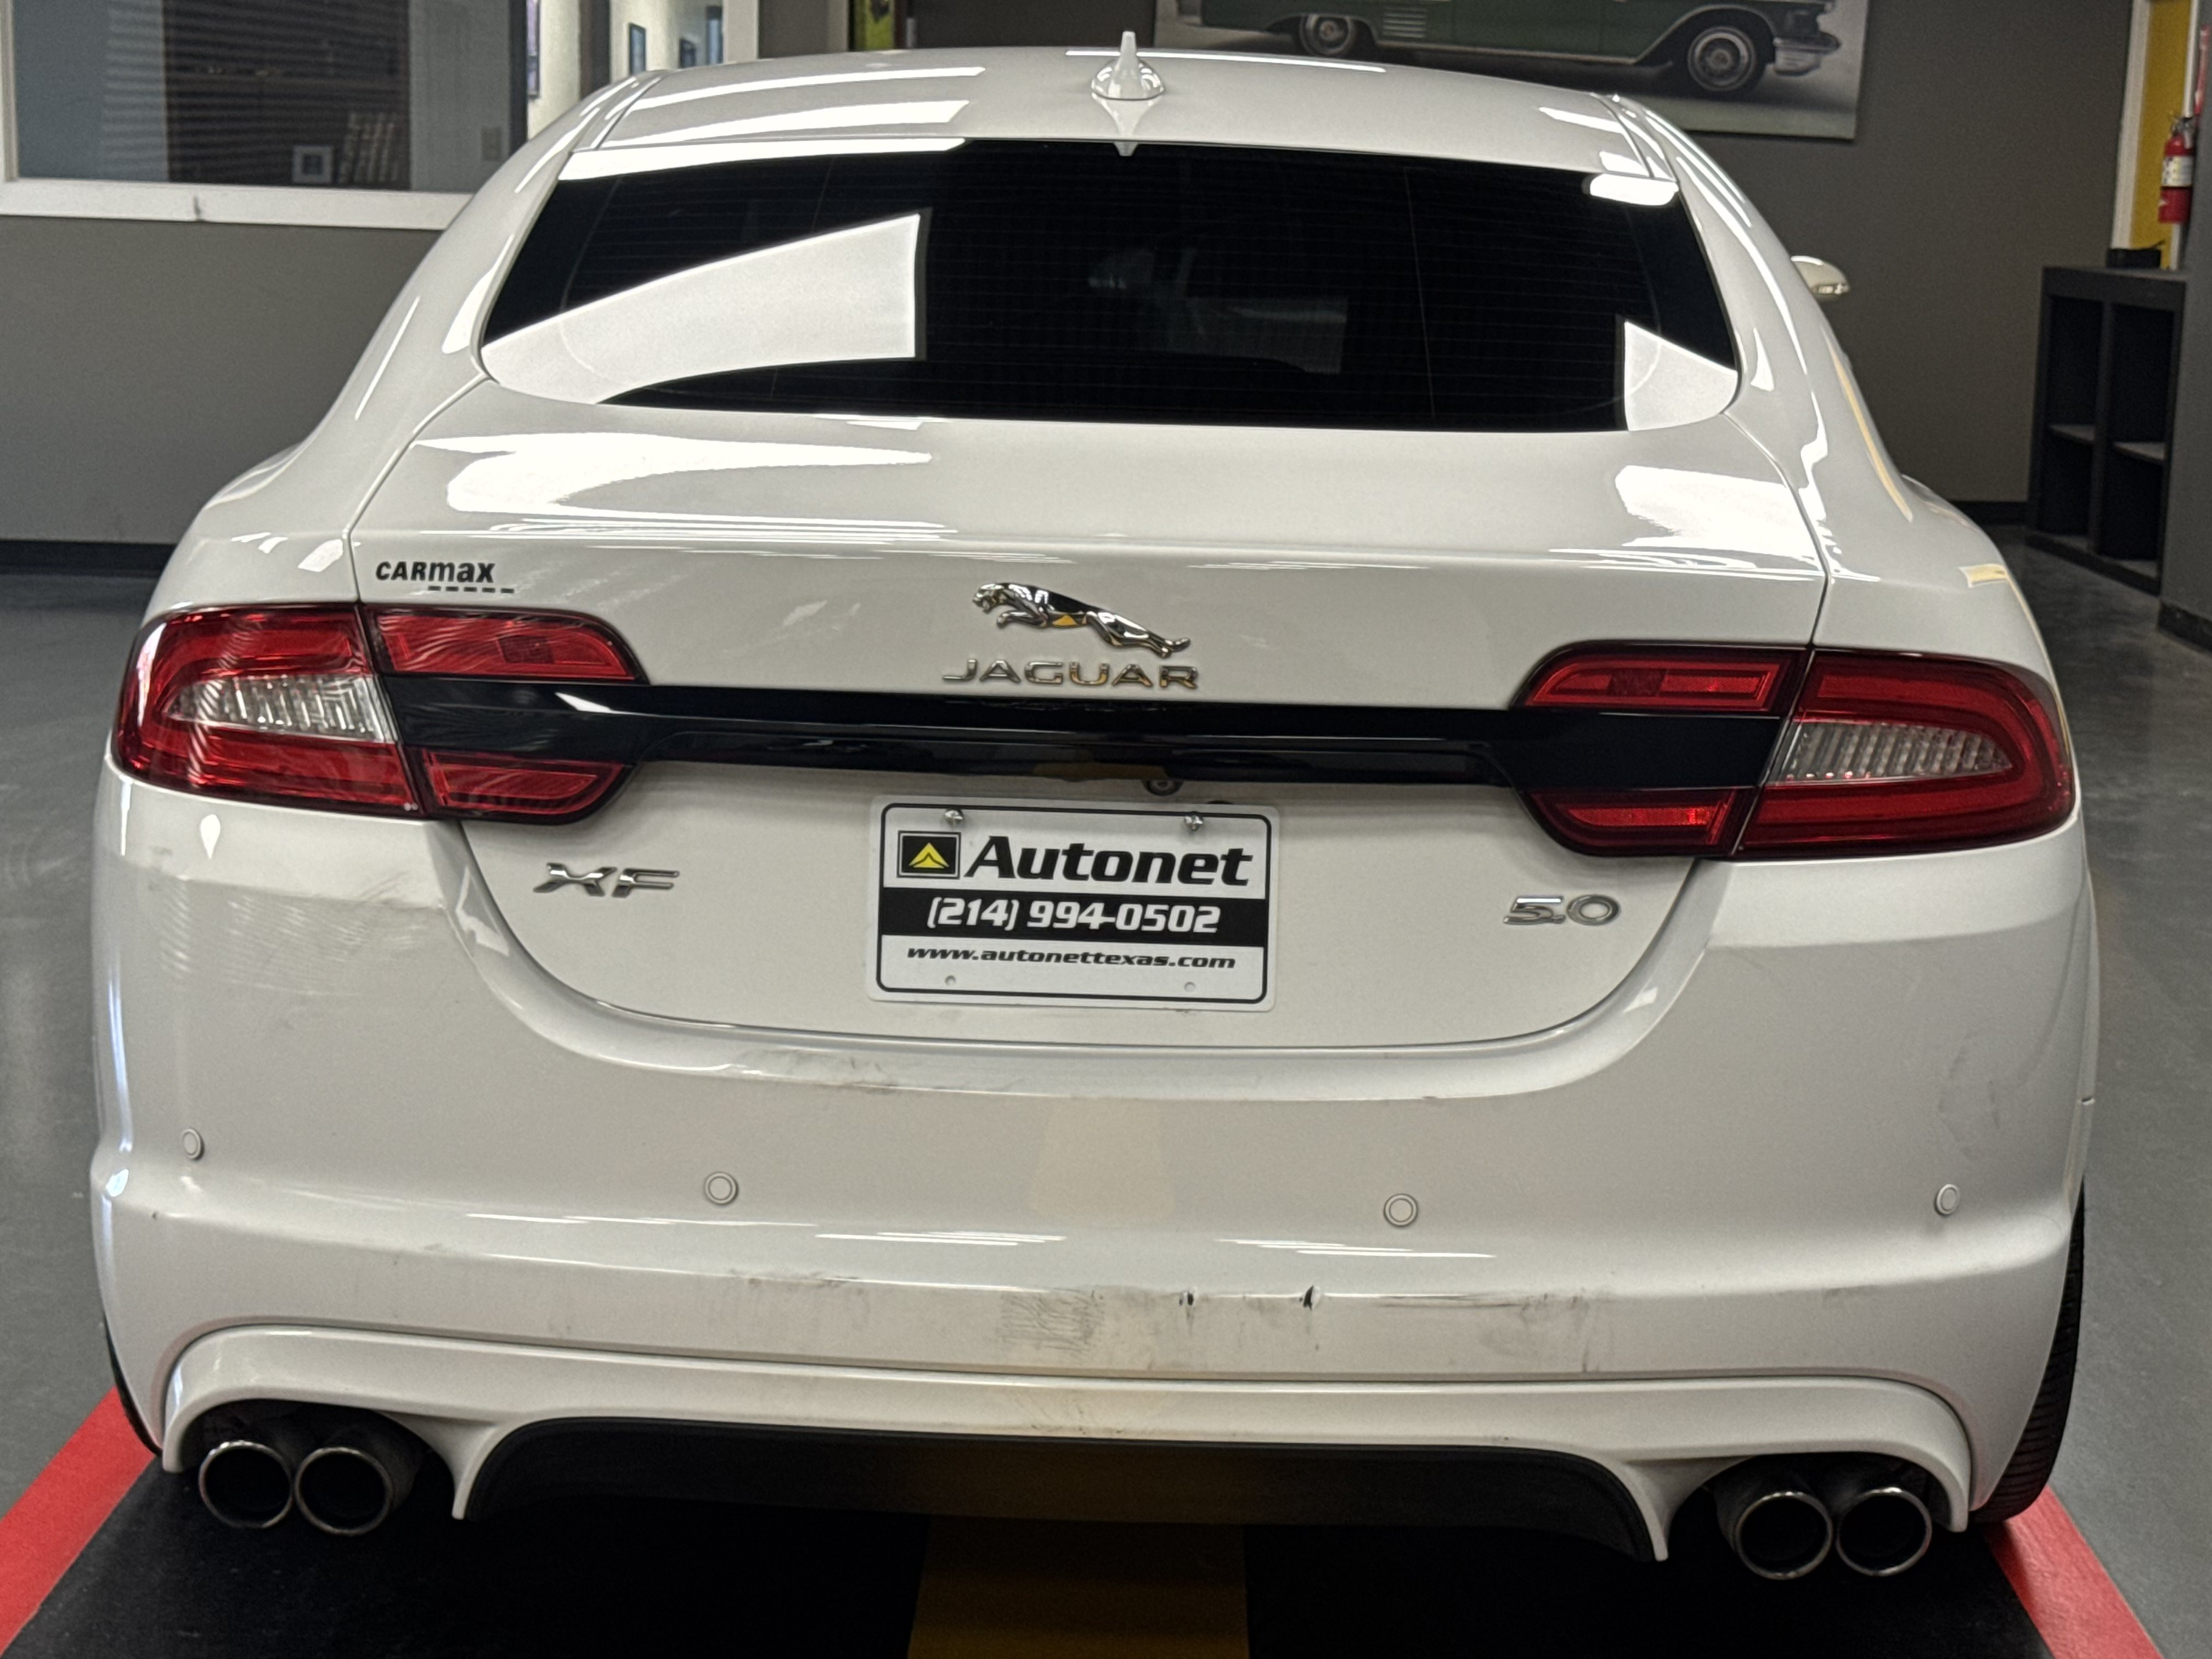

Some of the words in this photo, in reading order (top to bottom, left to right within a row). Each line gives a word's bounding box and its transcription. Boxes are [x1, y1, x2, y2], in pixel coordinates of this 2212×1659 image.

[942, 659, 1199, 689] JAGUAR
[963, 835, 1254, 887] Autonet
[533, 862, 680, 898] XF
[927, 897, 1019, 932] (214)
[1027, 900, 1221, 934] 994-0502
[907, 947, 1235, 969] www.autonettexas.com
